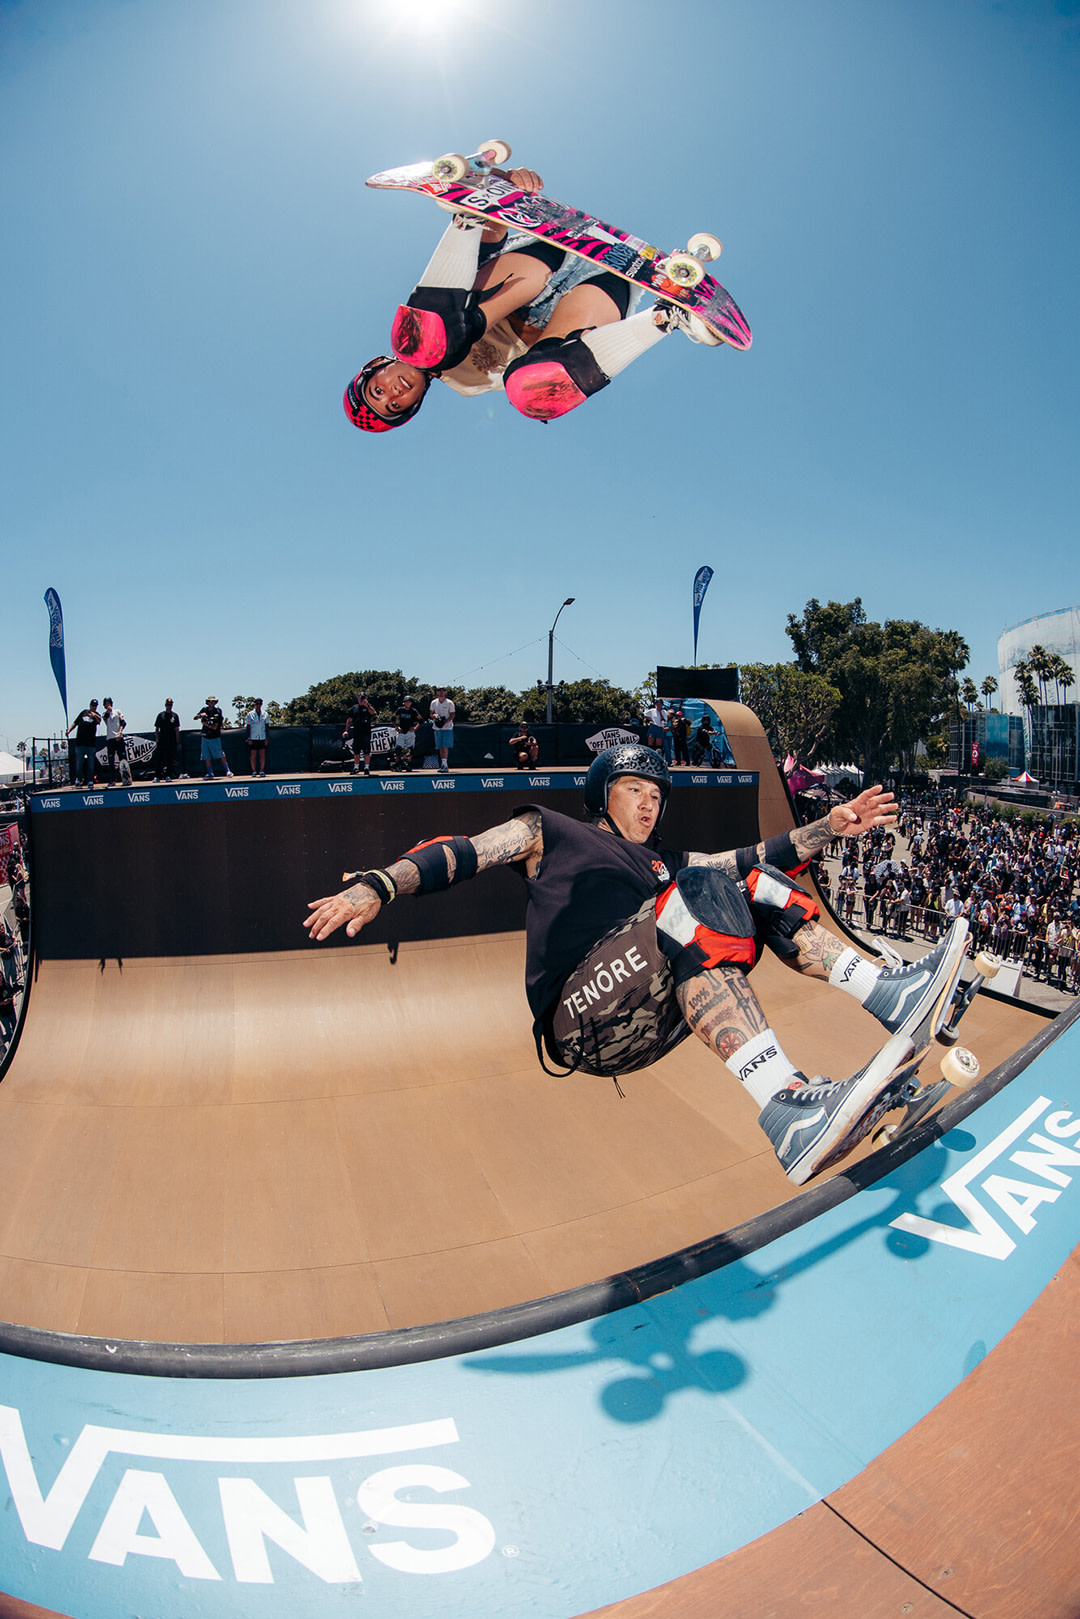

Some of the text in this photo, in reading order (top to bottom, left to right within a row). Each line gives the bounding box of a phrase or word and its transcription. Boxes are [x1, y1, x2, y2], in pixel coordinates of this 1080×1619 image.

[371, 728, 390, 740] ANS
[601, 729, 621, 740] VANS
[605, 738, 618, 748] THE
[432, 779, 456, 790] VANS
[481, 778, 504, 788] VANS
[528, 777, 551, 787] VANS
[573, 776, 587, 786] VA
[691, 775, 708, 784] VANS
[717, 775, 732, 784] VANS
[737, 775, 753, 783] VANS
[276, 784, 301, 795] VANS
[328, 782, 353, 793] VANS
[380, 780, 405, 791] VANS
[128, 792, 150, 803] VANS
[175, 789, 199, 800] VANS
[225, 786, 249, 798] VANS
[40, 798, 61, 809] VANS
[82, 795, 104, 806] VANS
[688, 986, 711, 1010] 100%
[736, 1045, 778, 1081] VANS
[888, 1095, 1080, 1261] VANS
